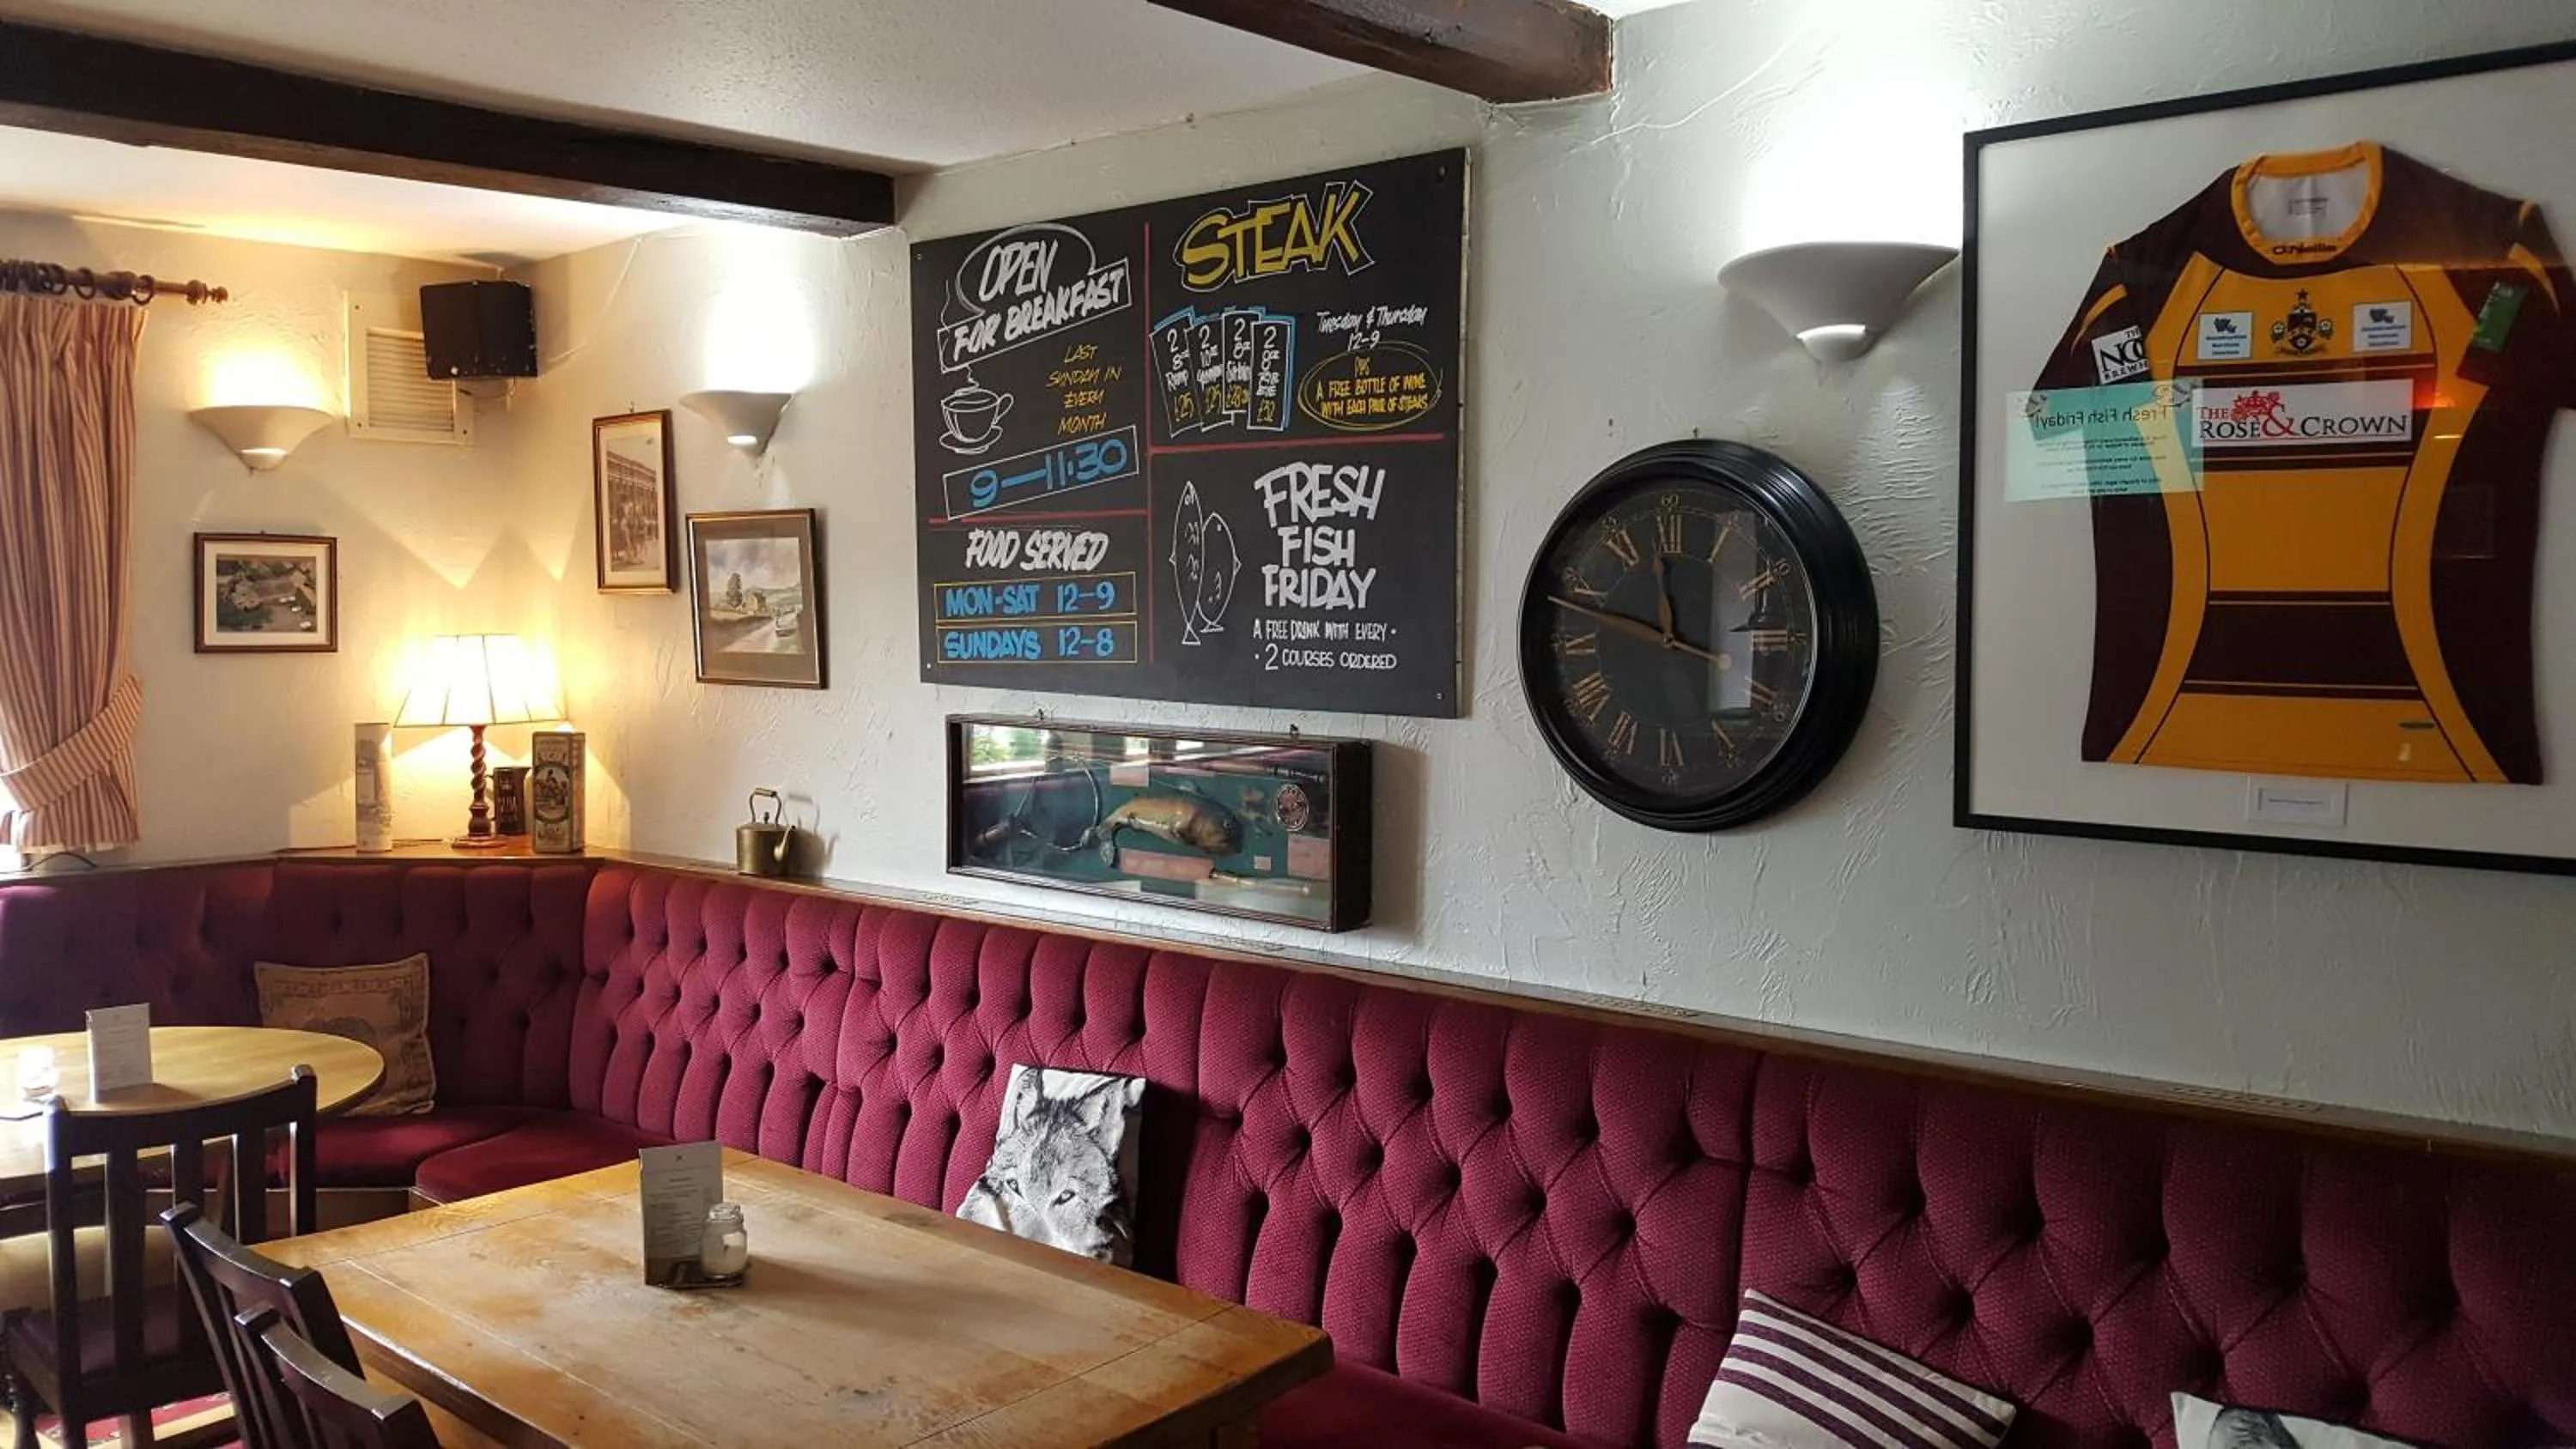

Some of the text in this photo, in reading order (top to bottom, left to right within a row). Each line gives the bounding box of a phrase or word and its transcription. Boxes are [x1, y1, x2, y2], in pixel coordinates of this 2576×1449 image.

[1182, 191, 1361, 285] STEAK
[978, 238, 1059, 302] OPEN
[953, 267, 1126, 362] FOR BREAKFAST
[1316, 312, 1363, 333] Tuesday
[1376, 305, 1428, 326] Thursday
[1167, 329, 1178, 352] 2
[1199, 324, 1210, 349] 2
[1234, 318, 1246, 341] 2
[1264, 325, 1277, 349] 2
[1347, 330, 1380, 351] 12-9
[1064, 344, 1099, 363] LAST
[1046, 367, 1121, 387] SUNDAY IN
[1315, 380, 1324, 402] A
[1328, 380, 1351, 397] FREE
[1355, 377, 1385, 396] BOTTLE
[1389, 375, 1400, 392] OF
[1063, 390, 1105, 409] EVERY
[1321, 401, 1344, 419] WITH
[1388, 397, 1398, 412] OF
[1058, 412, 1107, 435] MONTH
[2198, 407, 2229, 420] THE
[2200, 398, 2409, 439] ROSE & CROWN
[1255, 461, 1386, 528] FRESH
[965, 527, 1110, 572] FOOD SERVED
[1277, 524, 1356, 567] FISH
[945, 580, 1115, 617] MON-SAT 12-9
[1261, 563, 1376, 610] FRIDAY
[945, 627, 1115, 659] SUNDAYS 12-8
[1253, 618, 1388, 642] A FREE DRINK WITH EVERY
[1265, 643, 1397, 670] 2 COURSES ORDERED
